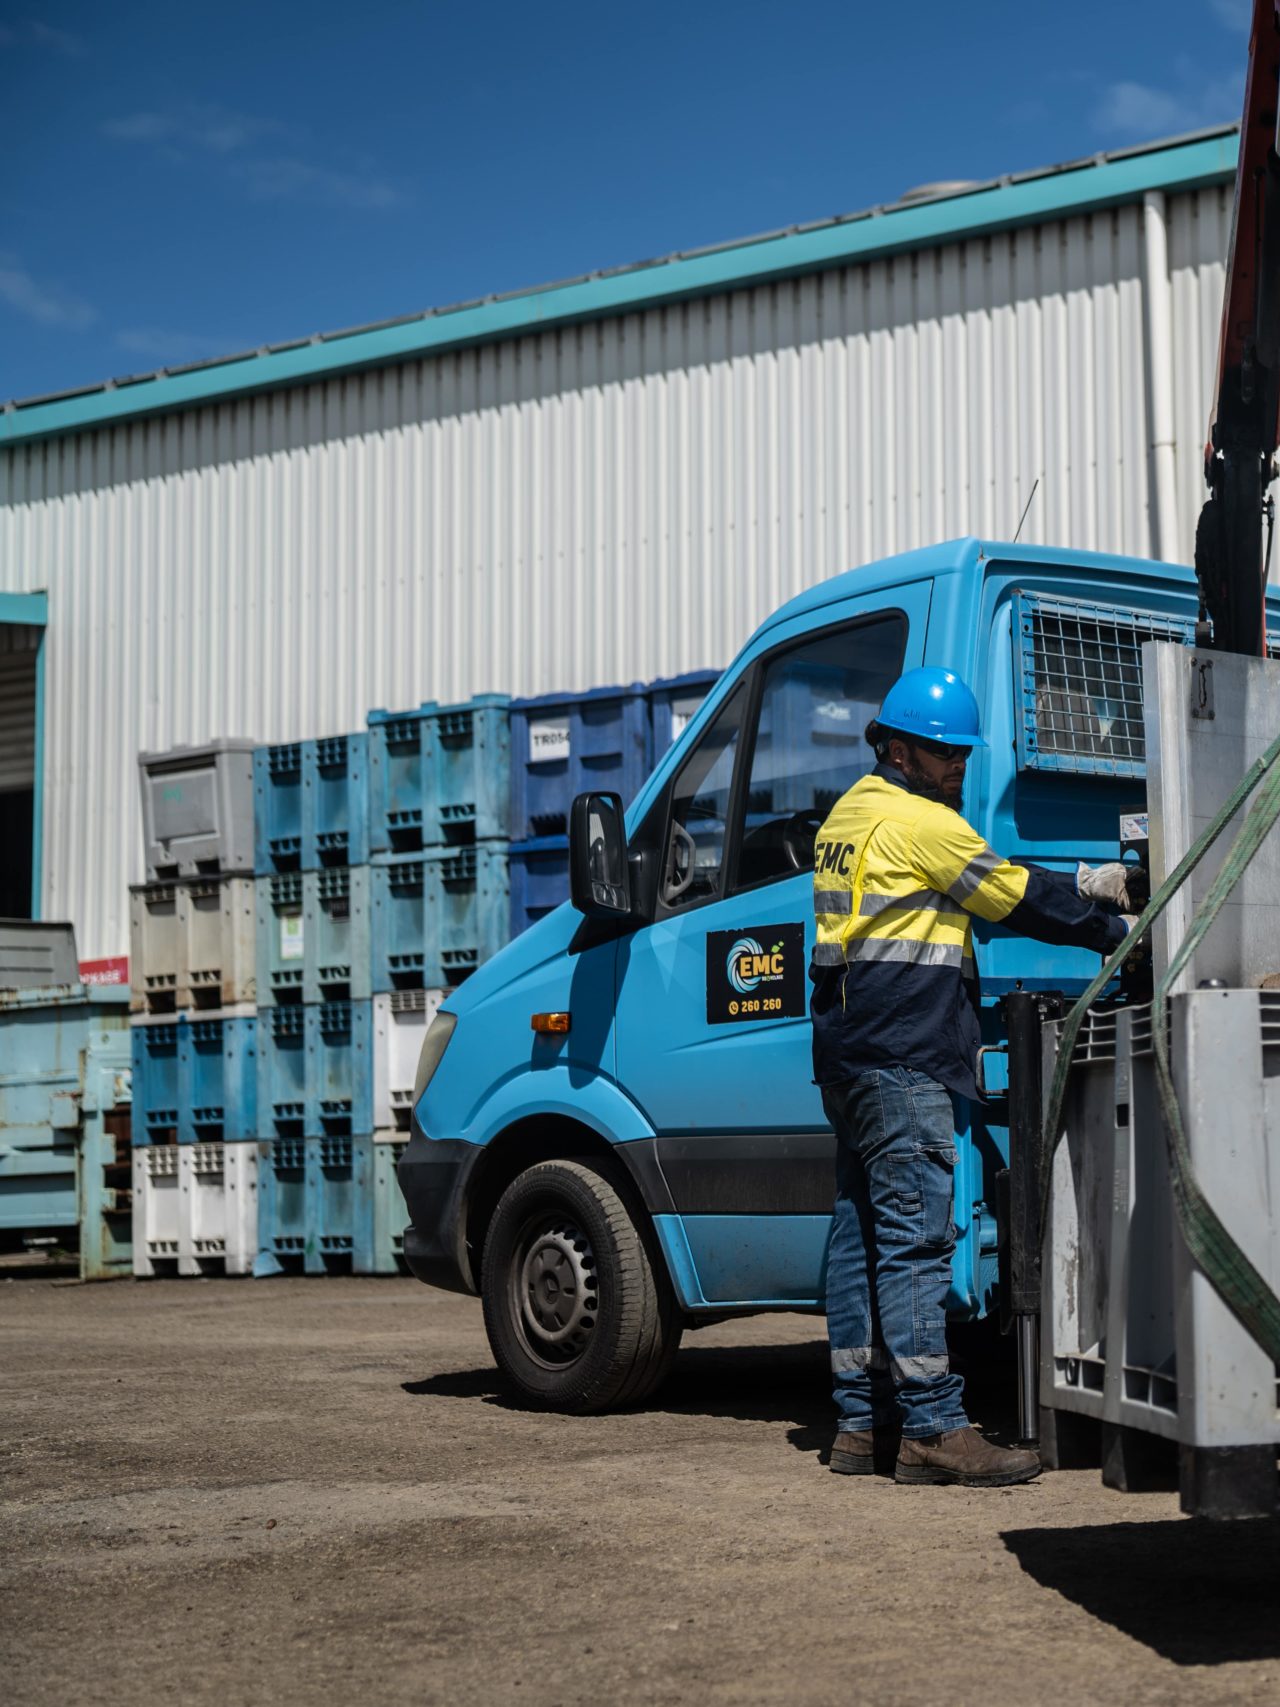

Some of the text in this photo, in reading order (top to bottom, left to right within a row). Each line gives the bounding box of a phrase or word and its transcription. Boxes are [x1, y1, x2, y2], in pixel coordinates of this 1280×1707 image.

[815, 842, 855, 876] EMC
[740, 953, 784, 977] EMC
[741, 998, 782, 1012] 260 260
